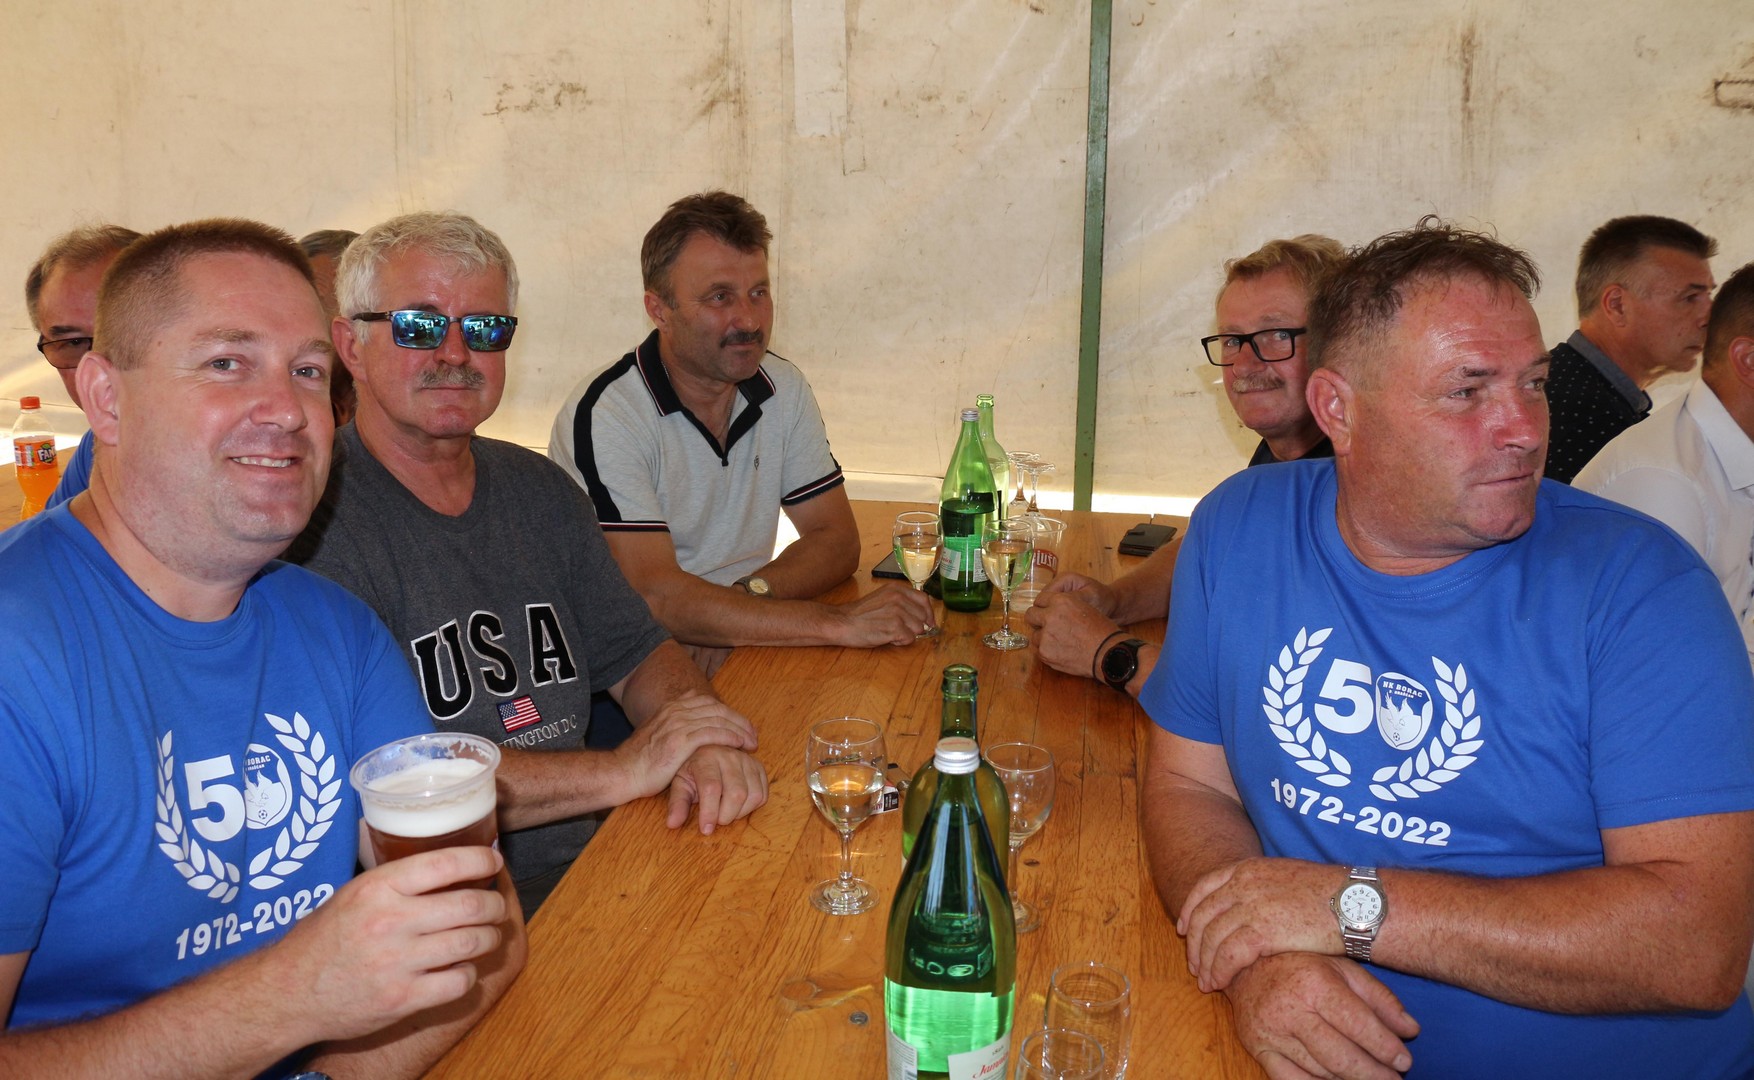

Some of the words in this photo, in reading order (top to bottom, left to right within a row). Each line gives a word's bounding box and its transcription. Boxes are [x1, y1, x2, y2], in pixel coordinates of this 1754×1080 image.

[410, 602, 579, 721] USA
[1382, 681, 1394, 689] NK
[1396, 684, 1423, 698] BORAC
[561, 714, 578, 734] DC
[1270, 777, 1452, 847] 1972-2022
[176, 883, 334, 960] 1972-2022
